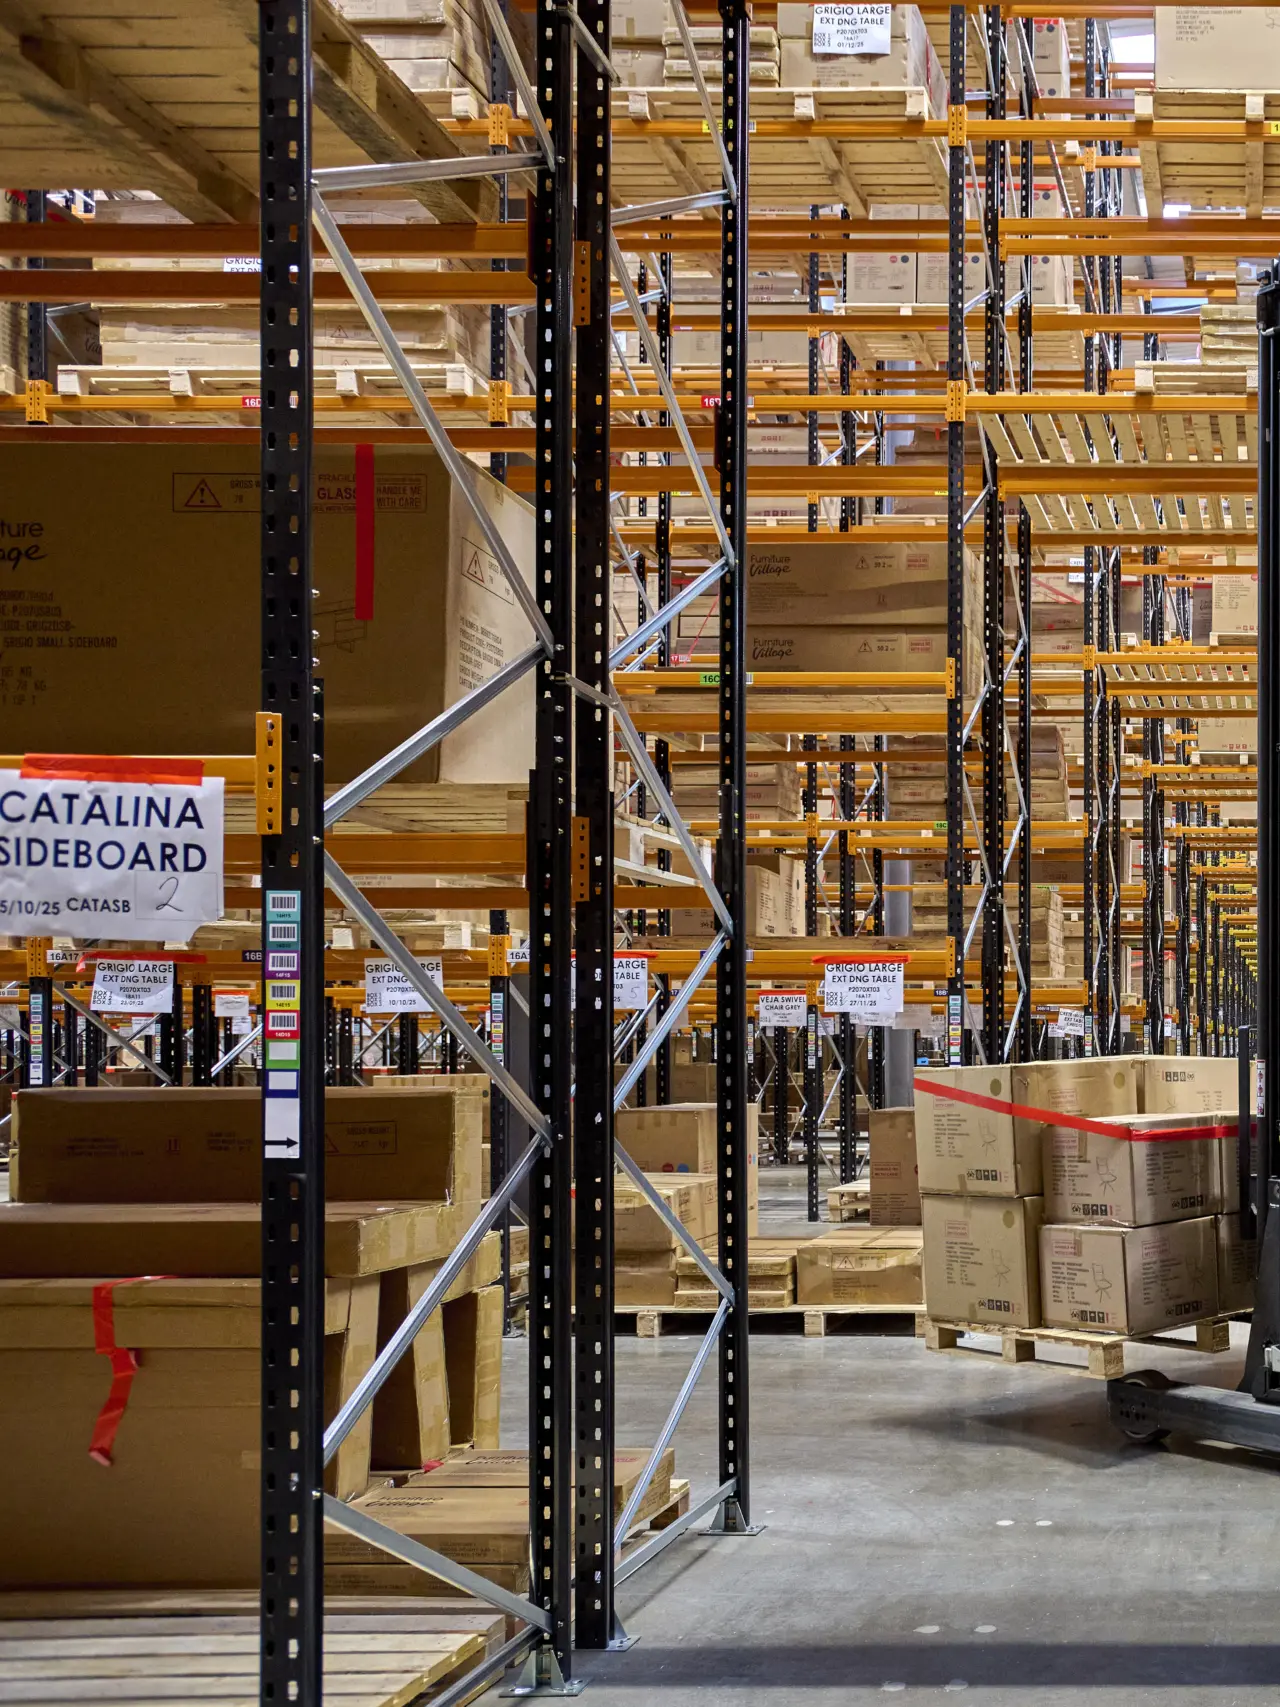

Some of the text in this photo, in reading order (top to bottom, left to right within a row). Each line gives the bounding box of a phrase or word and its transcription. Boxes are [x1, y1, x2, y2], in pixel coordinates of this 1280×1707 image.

[815, 6, 890, 15] GRIGIO LARGE
[837, 18, 857, 26] DNG
[860, 17, 884, 25] TABLE
[245, 398, 261, 407] 16D
[704, 398, 722, 406] 16D
[751, 554, 791, 564] Furniture
[750, 564, 792, 577] Village
[68, 636, 118, 648] SIDEBOARD
[754, 638, 794, 646] Furniture
[752, 647, 794, 660] Village
[703, 675, 720, 683] 16C
[0, 790, 204, 830] CATALINA
[0, 836, 207, 873] SIDEBOARD
[156, 876, 184, 913] 2
[66, 897, 131, 914] CATASB
[50, 953, 79, 962] 16A17
[244, 952, 262, 960] 16B
[510, 952, 530, 960] 16A
[98, 962, 172, 973] GRIGIO LARGE
[421, 962, 441, 972] RGE
[826, 964, 902, 972] GRIGIO LARGE
[102, 974, 168, 984] EXT DNG TABLE
[372, 975, 408, 984] EXT DNG
[615, 972, 640, 980] TABLE
